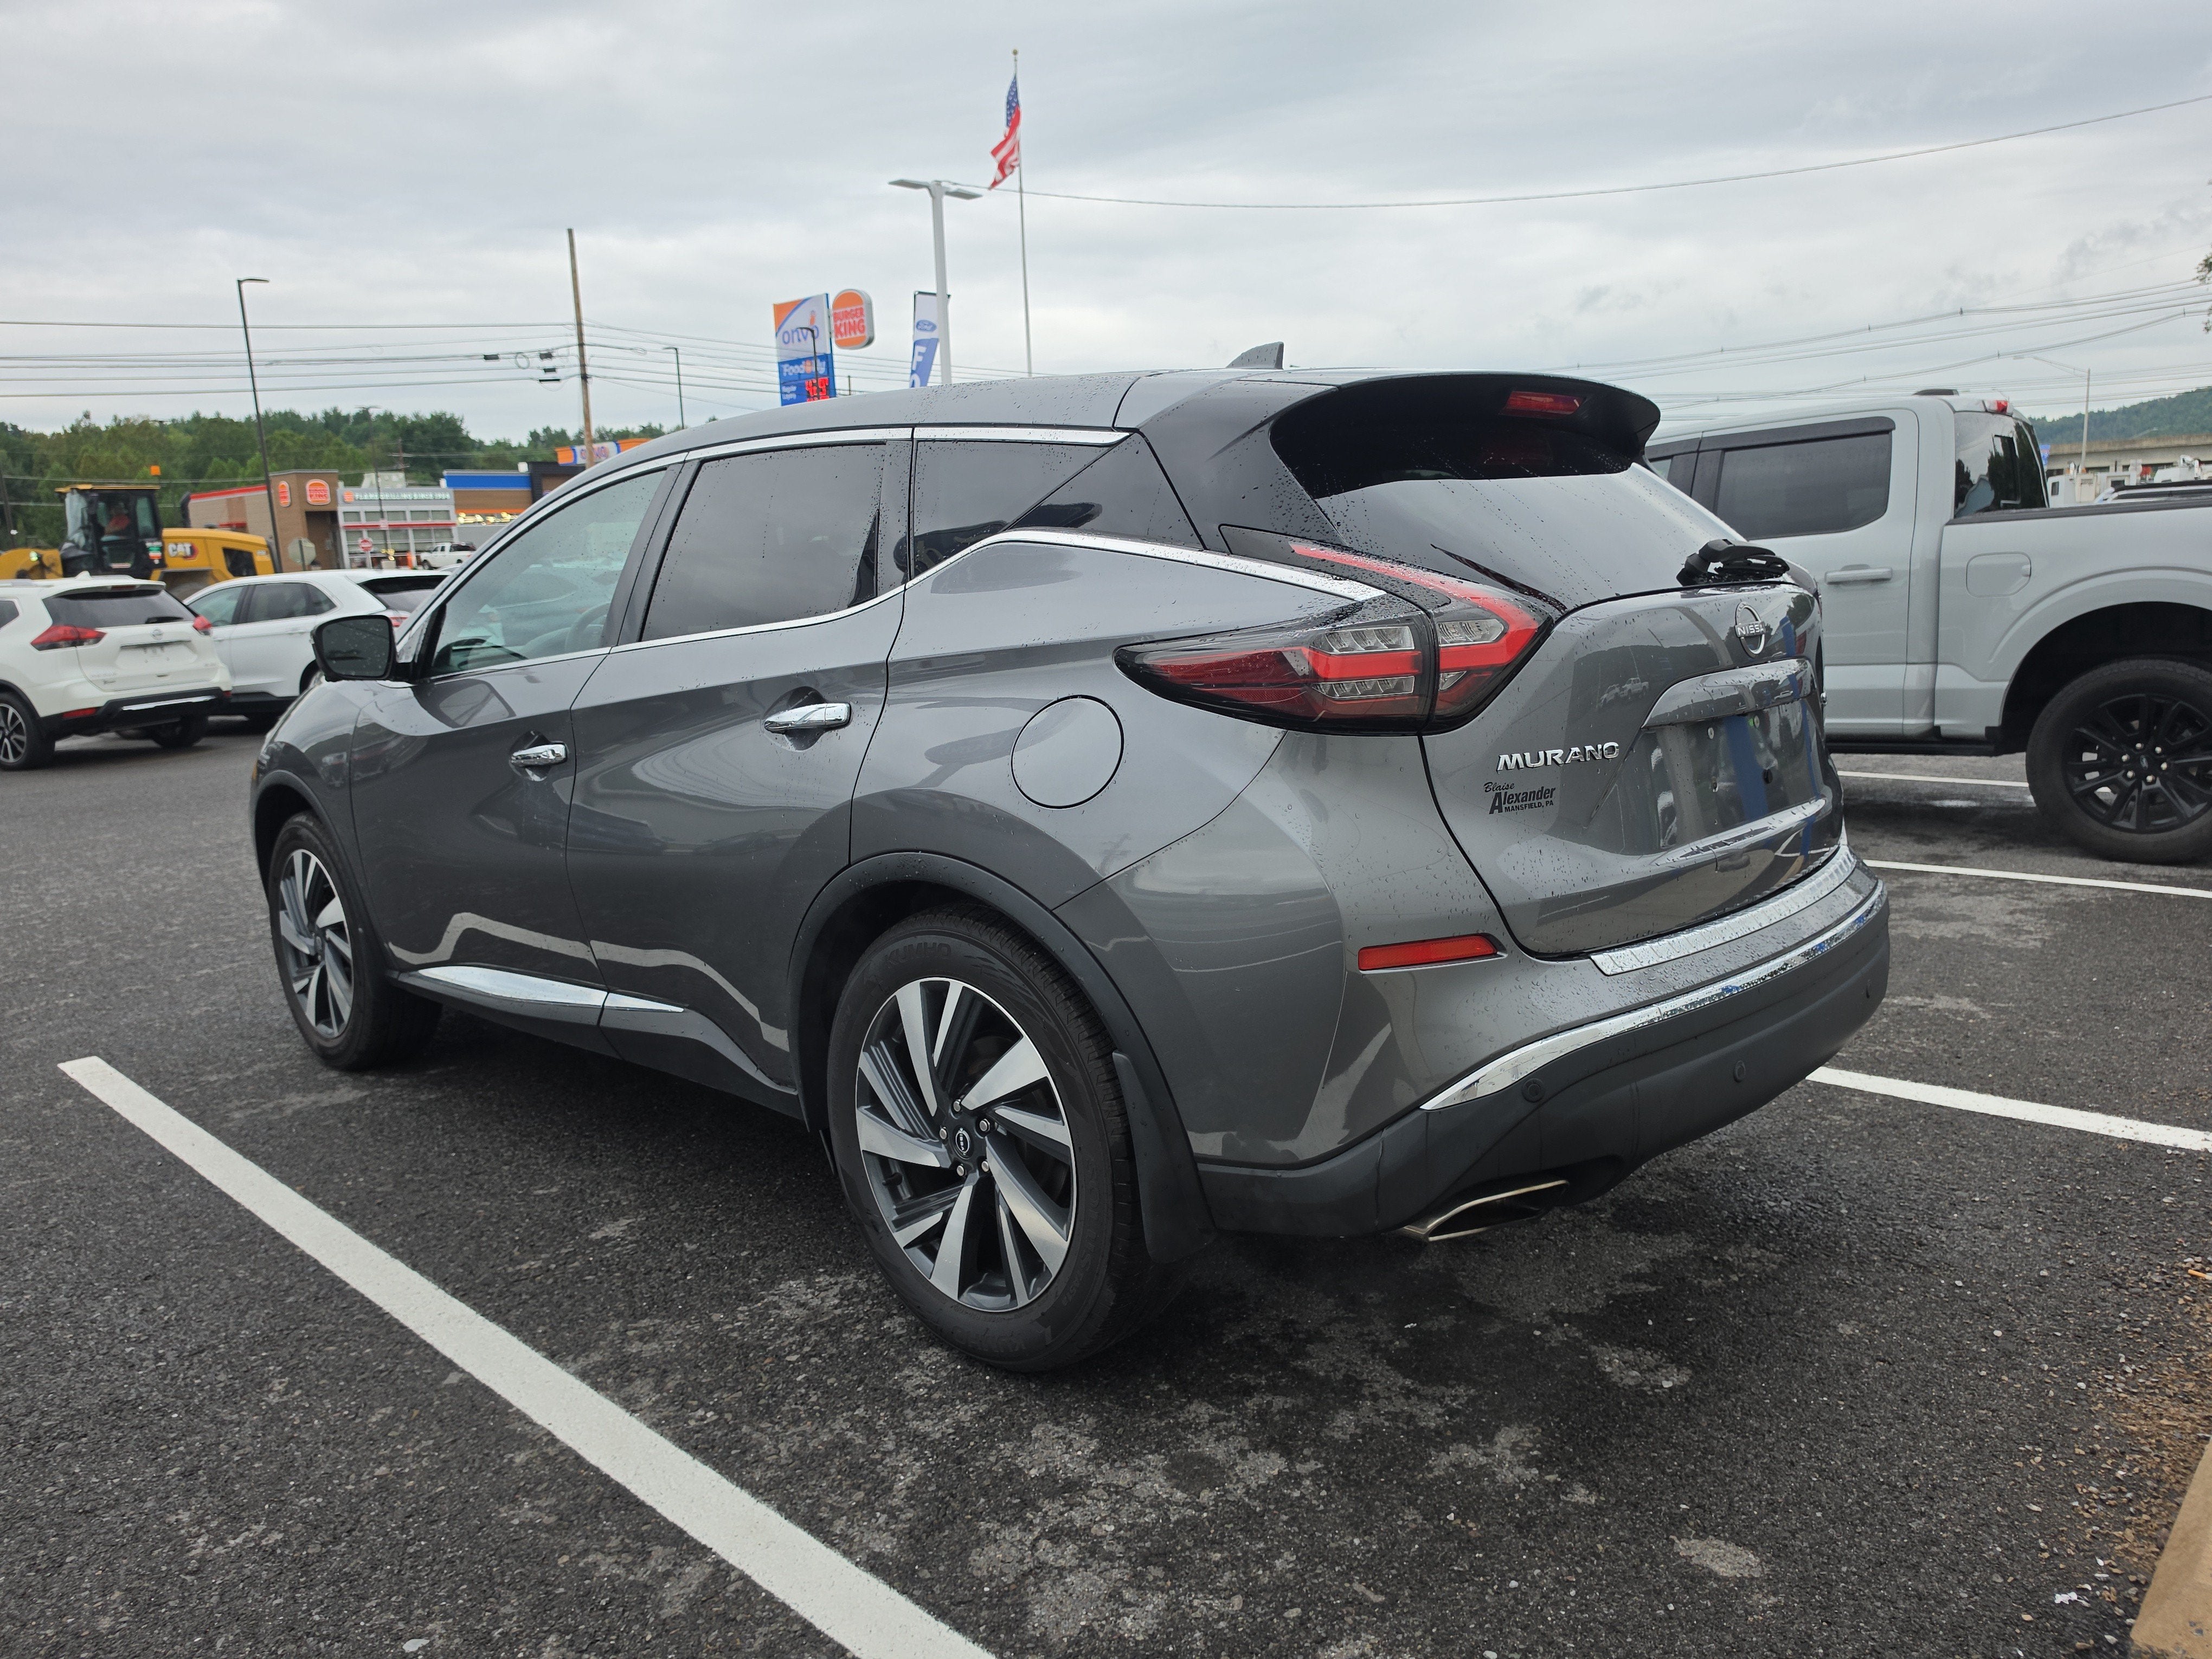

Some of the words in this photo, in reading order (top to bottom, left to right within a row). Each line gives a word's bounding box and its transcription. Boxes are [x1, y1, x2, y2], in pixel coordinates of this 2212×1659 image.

[833, 307, 864, 322] BURGER
[834, 318, 865, 338] KING
[168, 542, 192, 557] CAT
[1737, 623, 1765, 636] NISSA
[1496, 742, 1620, 772] MURANO
[1483, 781, 1515, 793] Blaise
[1489, 786, 1556, 815] Alexander
[1504, 803, 1544, 813] MANSFIELD,
